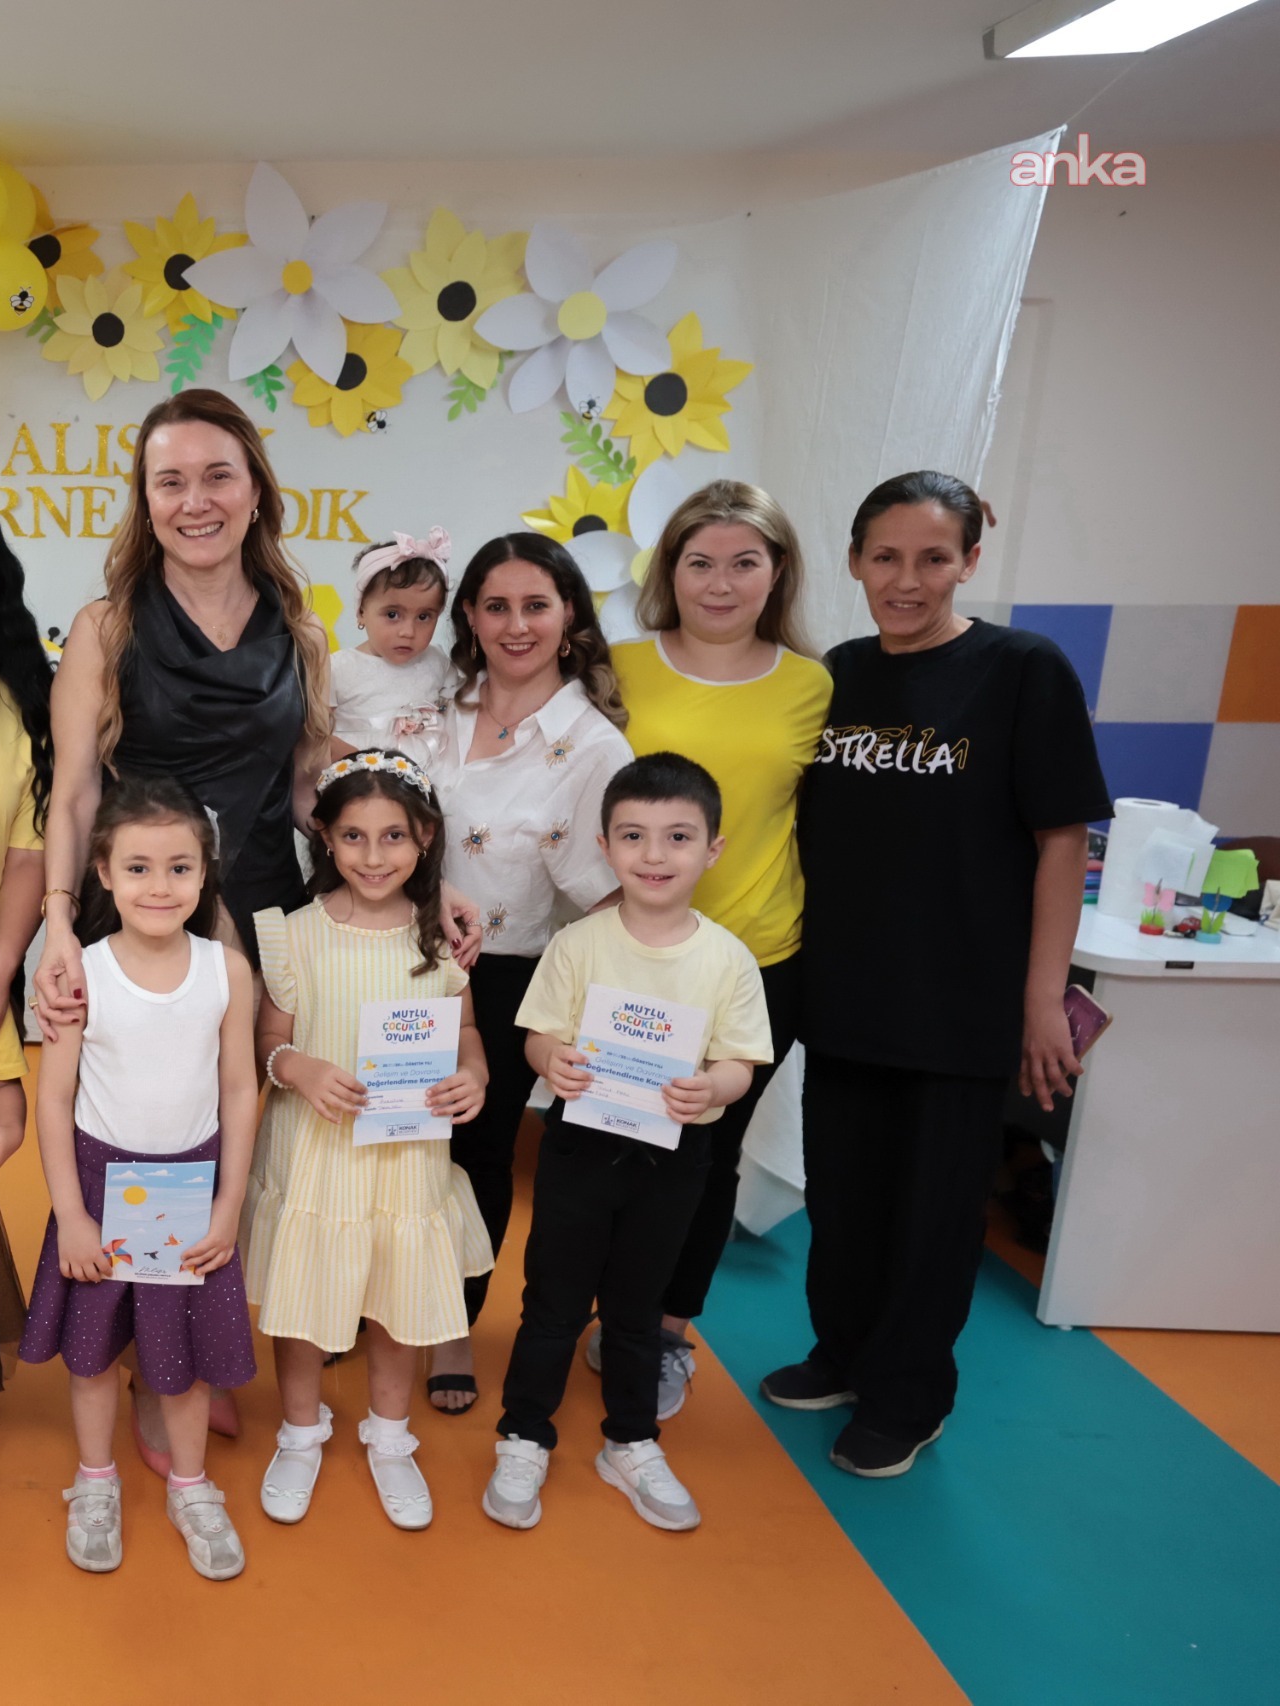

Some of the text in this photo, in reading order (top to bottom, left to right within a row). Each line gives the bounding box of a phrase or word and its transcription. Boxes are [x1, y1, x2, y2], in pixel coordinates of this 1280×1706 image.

[279, 486, 372, 543] DIK
[814, 727, 956, 775] STRELLA
[392, 1009, 428, 1019] MUTLU
[624, 1003, 666, 1020] MUTLU
[382, 1019, 434, 1031] ÇOCUKLAR
[611, 1011, 672, 1032] ÇOCUKLAR
[386, 1031, 431, 1042] OYUN EVİ
[614, 1022, 666, 1042] OYUN EVİ
[586, 1062, 645, 1083] Değerlendirme
[367, 1079, 418, 1087] Değerlendirme
